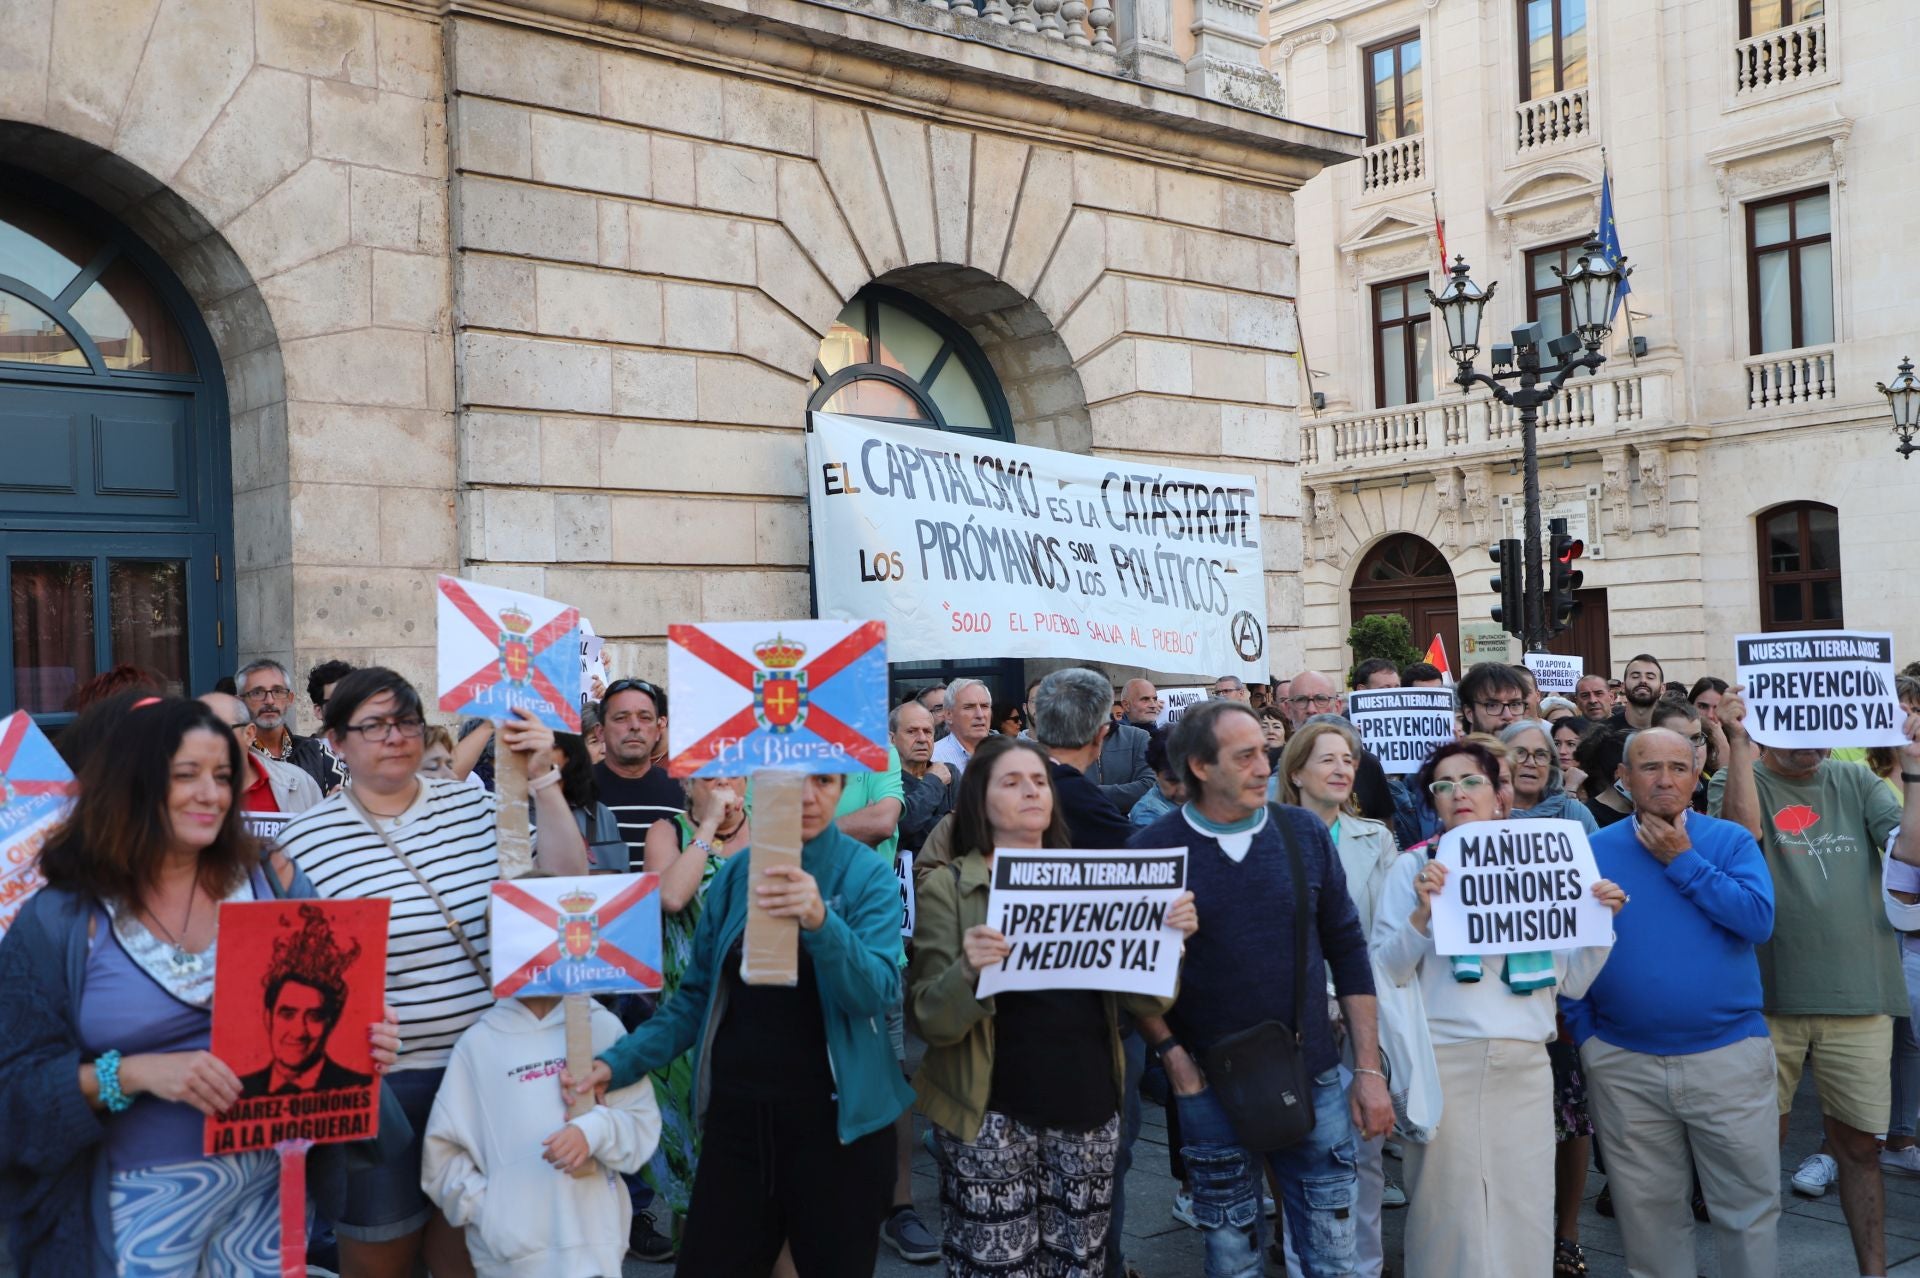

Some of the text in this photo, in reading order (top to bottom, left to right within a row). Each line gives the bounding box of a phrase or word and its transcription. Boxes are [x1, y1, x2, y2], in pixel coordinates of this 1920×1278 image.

[823, 438, 1258, 549] EL CAPITALISMO ES LA CATÁSTROFE
[859, 514, 1229, 616] LOS PIRÓMANOS SON LOS POLÍTICOS
[1009, 612, 1029, 632] EL
[1034, 612, 1080, 636] PUEBLO
[1087, 620, 1126, 646] SALVA
[1130, 626, 1147, 648] AL
[1536, 660, 1544, 668] YO
[1544, 660, 1567, 668] APOYO
[1749, 639, 1881, 661] NUESTRA TIERRA ARDE
[1748, 665, 1889, 699] ¡PREVENCIÓN
[1357, 694, 1450, 710] NUESTRA TIERRA ARDE
[1754, 702, 1894, 731] Y MEDIOS YA!
[710, 736, 845, 765] El Bierzo
[1459, 828, 1574, 868] MAÑUECO
[1009, 861, 1177, 886] NUESTRA TIERRA ARDE
[1459, 866, 1583, 907] QUIÑONES
[1001, 895, 1167, 937] ¡PREVENCIÓN
[1467, 902, 1578, 945] DIMISIÓN
[1017, 938, 1115, 971] MEDIOS
[1119, 939, 1160, 972] YA!
[526, 963, 627, 987] El Bierzo
[213, 1112, 371, 1153] ¡A LA HOGUERA!
